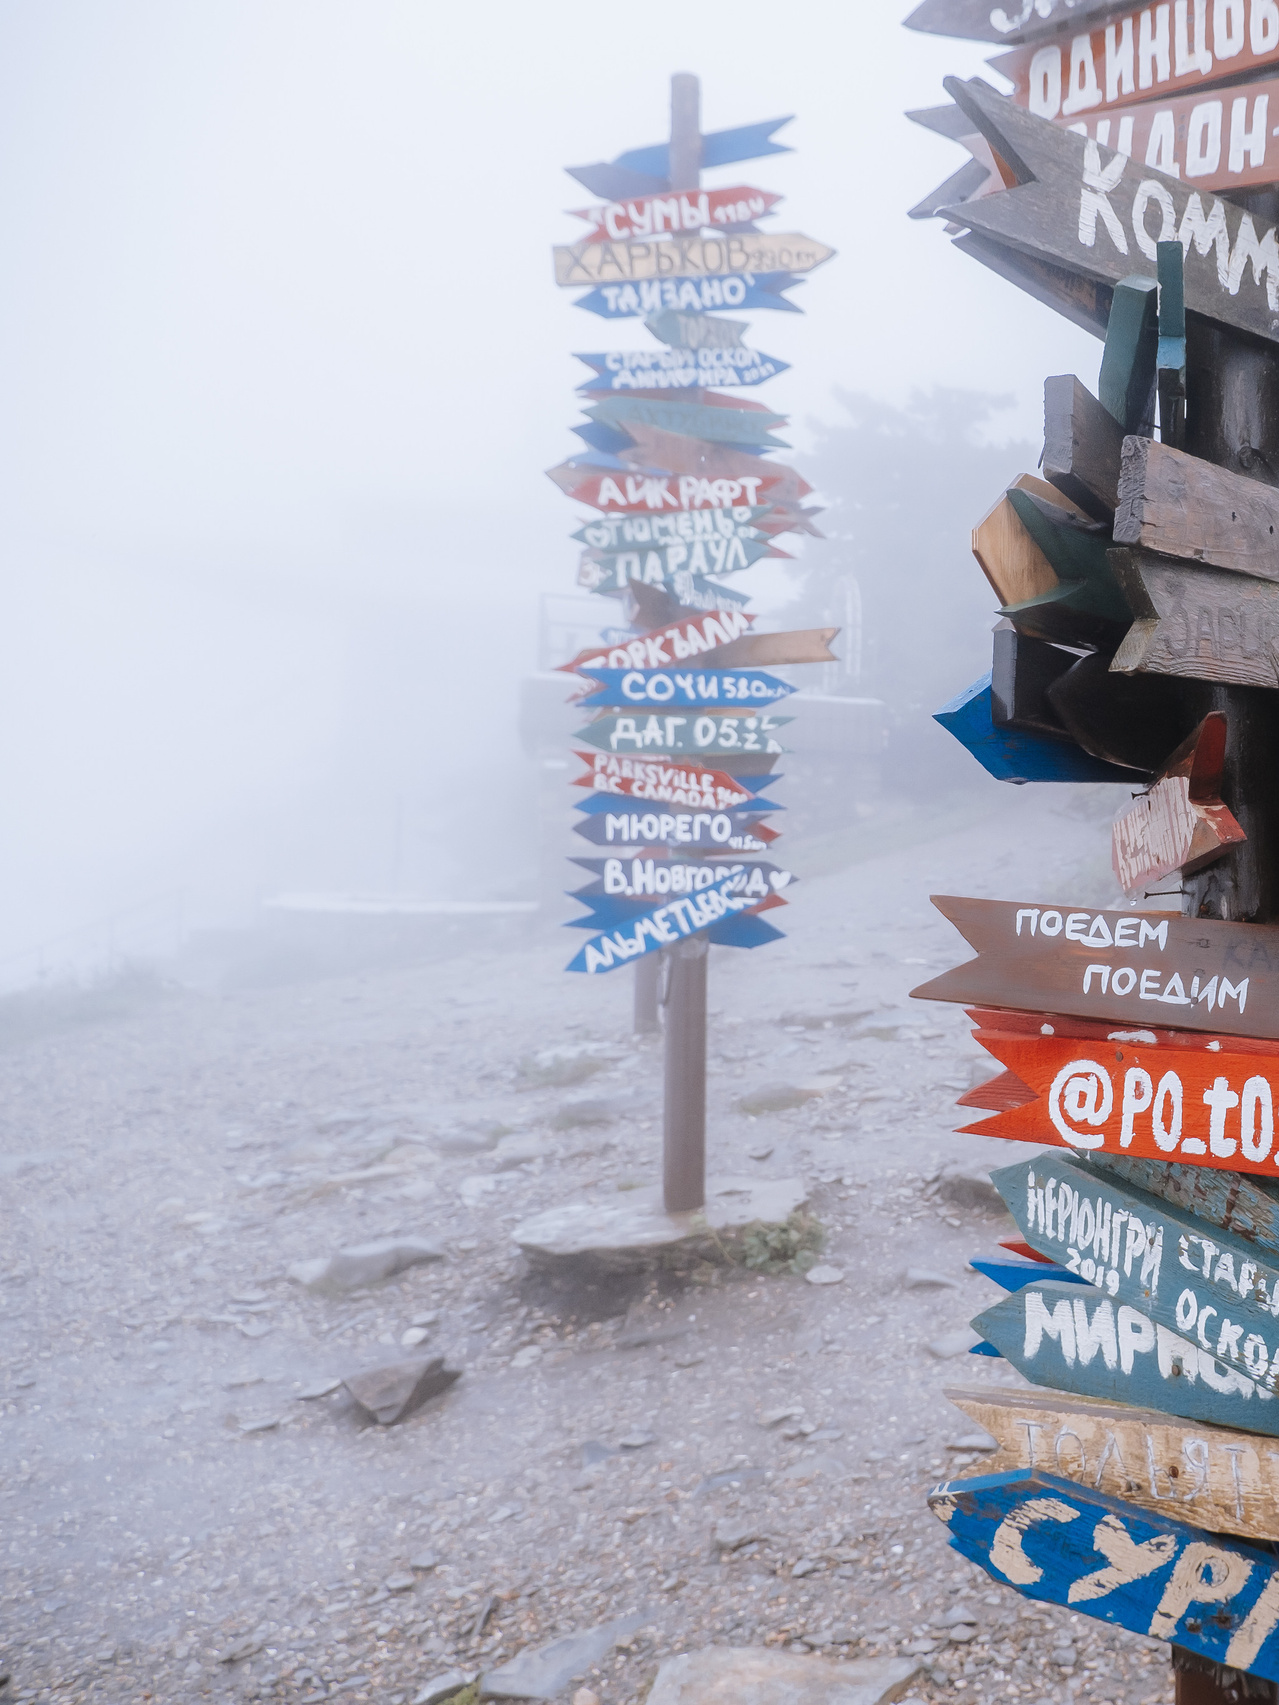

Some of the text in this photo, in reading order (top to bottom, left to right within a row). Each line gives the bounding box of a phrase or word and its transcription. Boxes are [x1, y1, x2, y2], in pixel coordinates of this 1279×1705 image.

[604, 193, 710, 239] СУМЫ
[564, 239, 750, 280] ХАРЬКОВ
[603, 508, 735, 546] ТЮМЕНЬ
[615, 537, 749, 587] ПАРАУЛ
[621, 671, 719, 700] СОЧИ
[722, 676, 768, 699] 580
[593, 754, 715, 792] PARKSVILLE
[605, 813, 732, 842] МЮРЕГО
[1016, 908, 1169, 952] ПОЕДЕМ
[1083, 964, 1251, 1014] ПОЕДИМ
[1027, 1165, 1165, 1297] НЕРЮНГРИ
[1064, 1247, 1120, 1297] 2019
